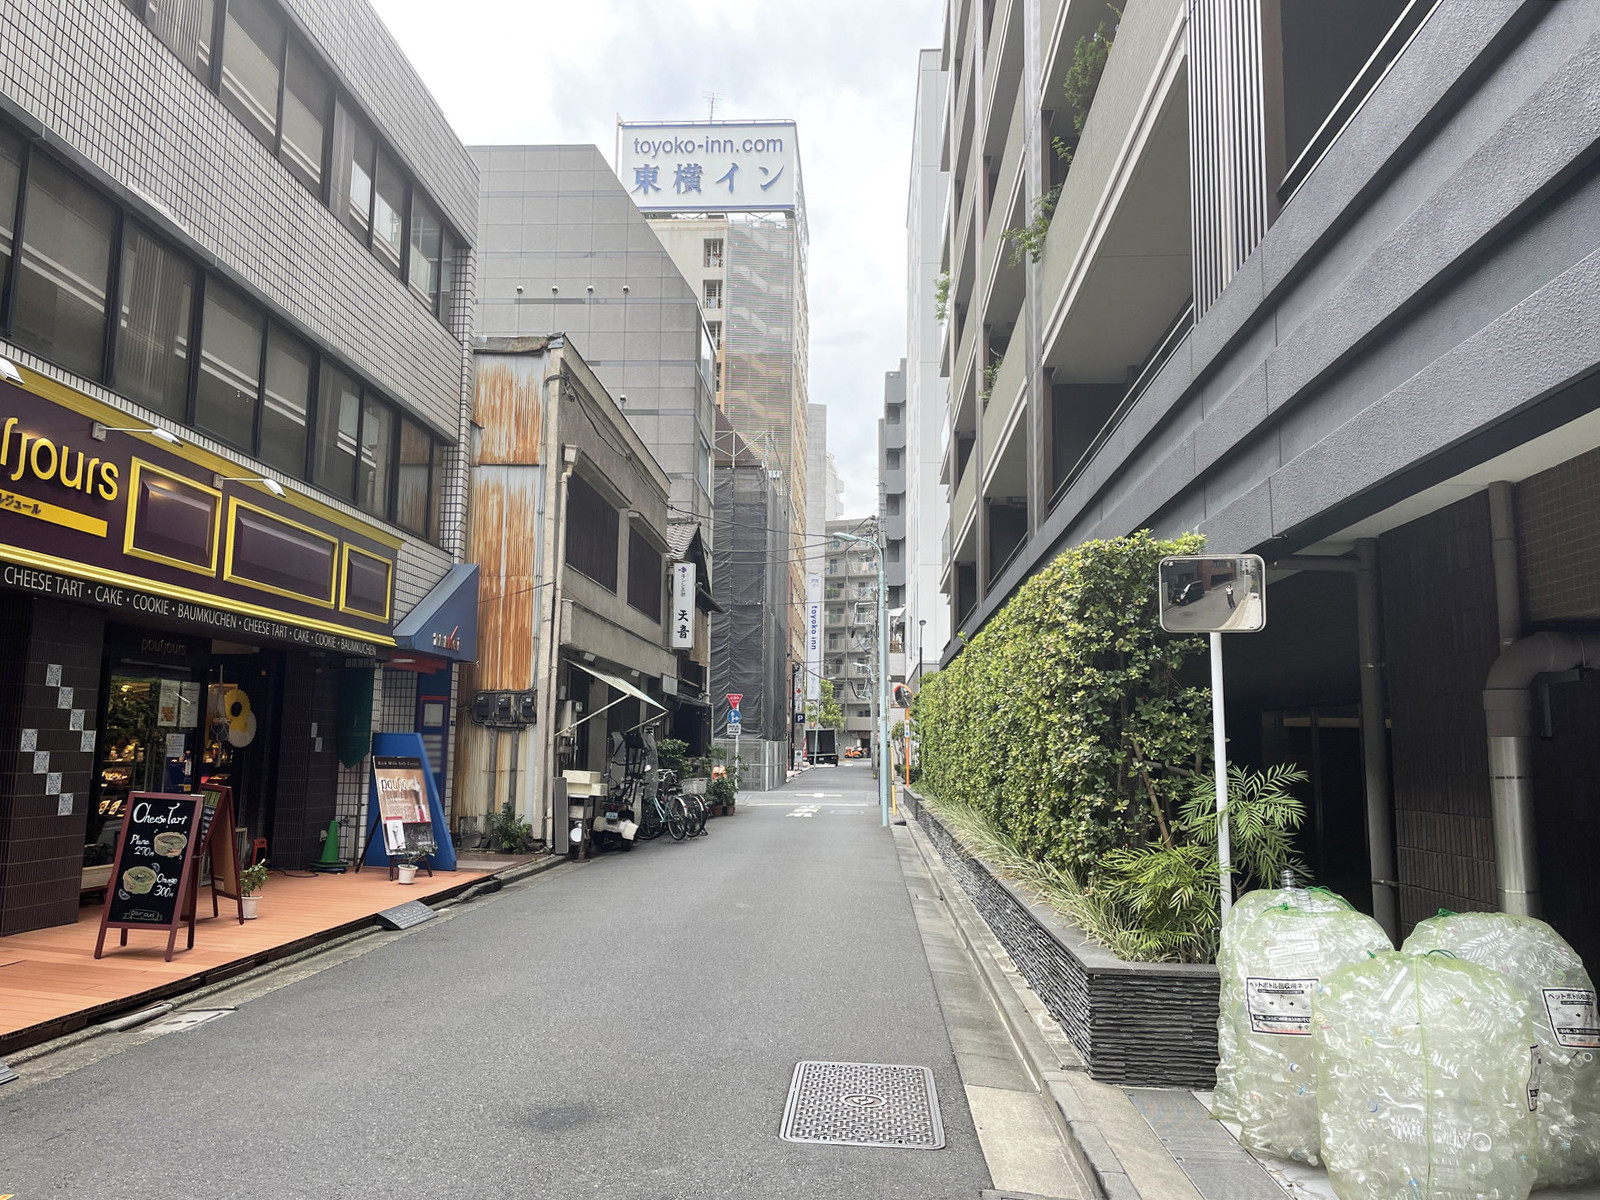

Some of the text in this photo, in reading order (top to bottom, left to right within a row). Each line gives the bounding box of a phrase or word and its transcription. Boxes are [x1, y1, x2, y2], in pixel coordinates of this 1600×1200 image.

[633, 136, 783, 159] toyoko-inn.com
[631, 162, 785, 195] 東横イン
[4, 566, 377, 656] CHEESE TART CAKE COOKIE BAUMKUCHEN CHEESE TART CAKE COOKIE BAUMKUCHEN
